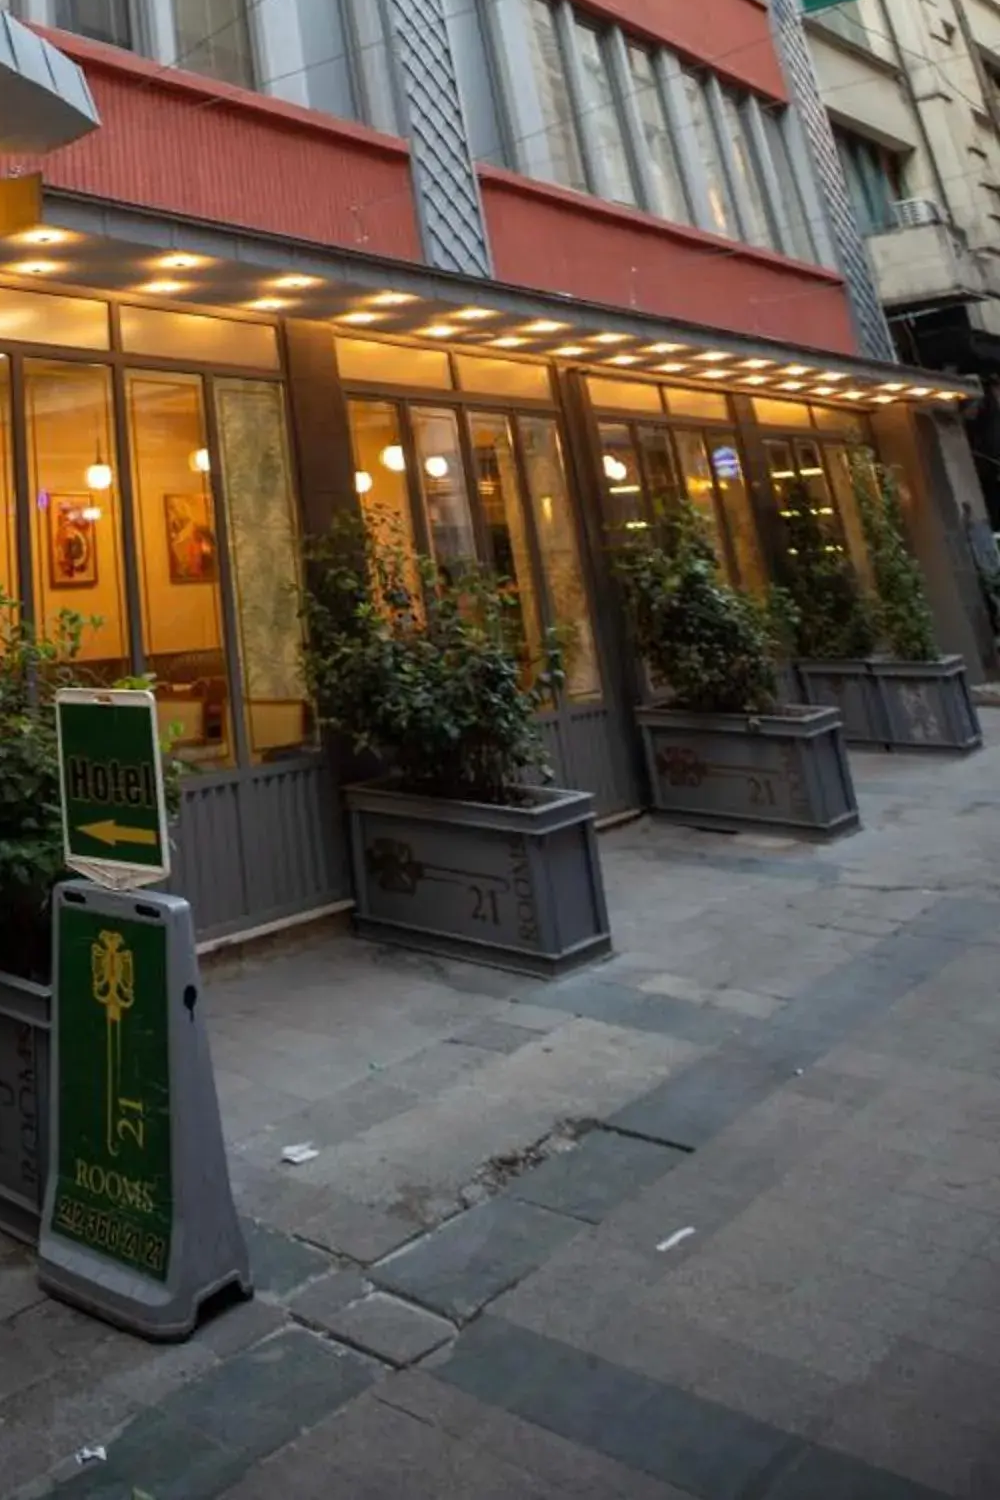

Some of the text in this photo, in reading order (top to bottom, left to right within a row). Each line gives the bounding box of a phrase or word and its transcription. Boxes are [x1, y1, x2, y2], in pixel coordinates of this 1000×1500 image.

[67, 756, 156, 809] Hotel
[468, 884, 501, 927] 21
[116, 1096, 145, 1151] 21
[74, 1157, 154, 1213] ROOMS
